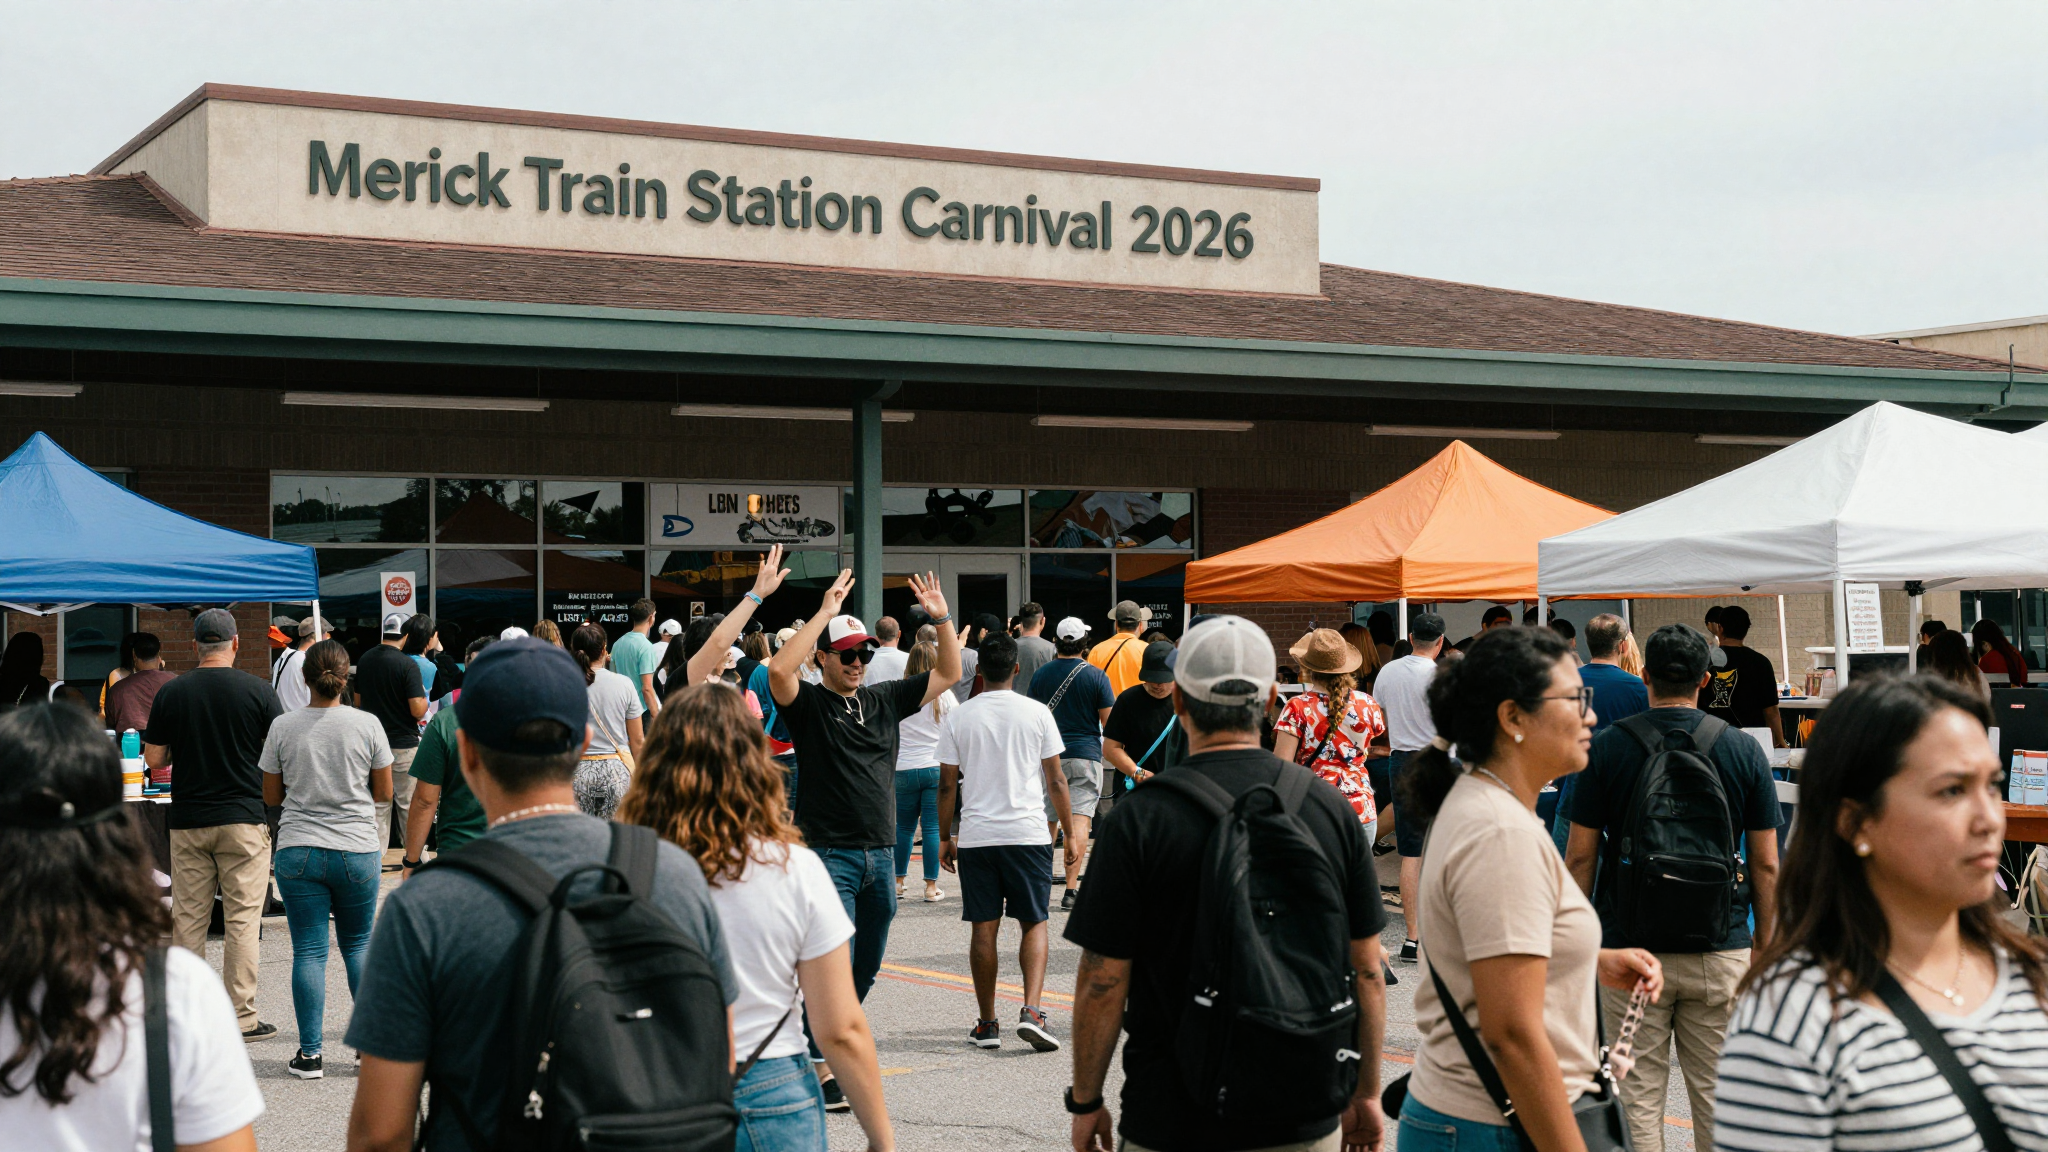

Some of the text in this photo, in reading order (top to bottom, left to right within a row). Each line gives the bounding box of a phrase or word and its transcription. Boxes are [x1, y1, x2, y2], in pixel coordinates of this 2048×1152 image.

[309, 140, 1254, 260] Merick Train Station Carnival 2026
